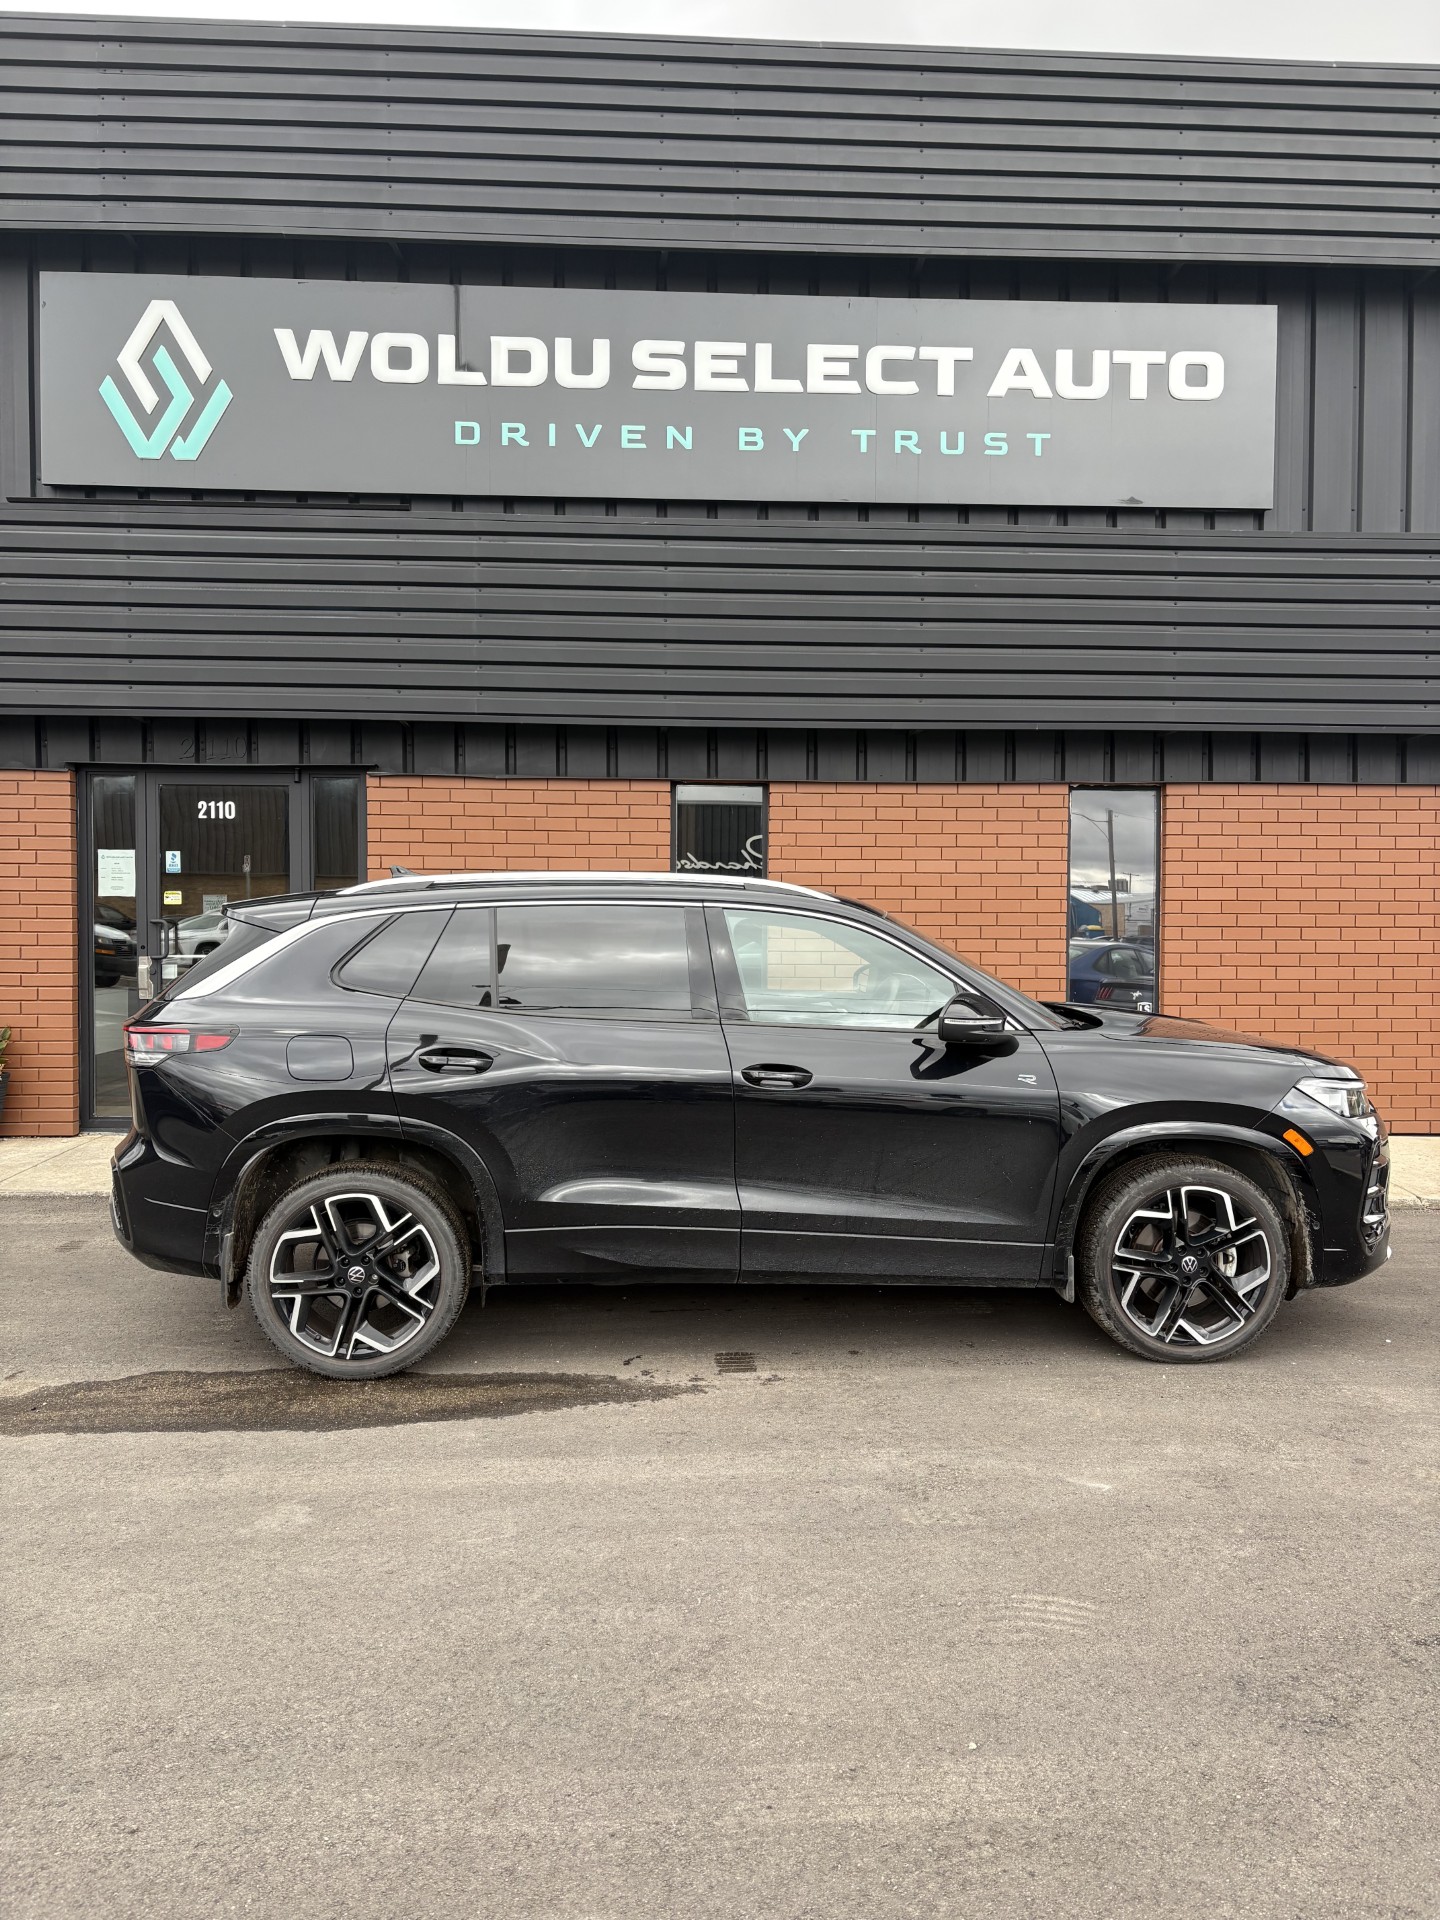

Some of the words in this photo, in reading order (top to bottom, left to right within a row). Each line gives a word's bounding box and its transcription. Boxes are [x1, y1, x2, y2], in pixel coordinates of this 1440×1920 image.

[273, 327, 611, 391] WOLDU
[631, 338, 974, 397] SELECT
[986, 347, 1226, 403] AUTO
[454, 420, 694, 452] DRIVEN
[737, 426, 811, 453] BY
[850, 428, 1053, 458] TRUST
[197, 800, 236, 820] 2110
